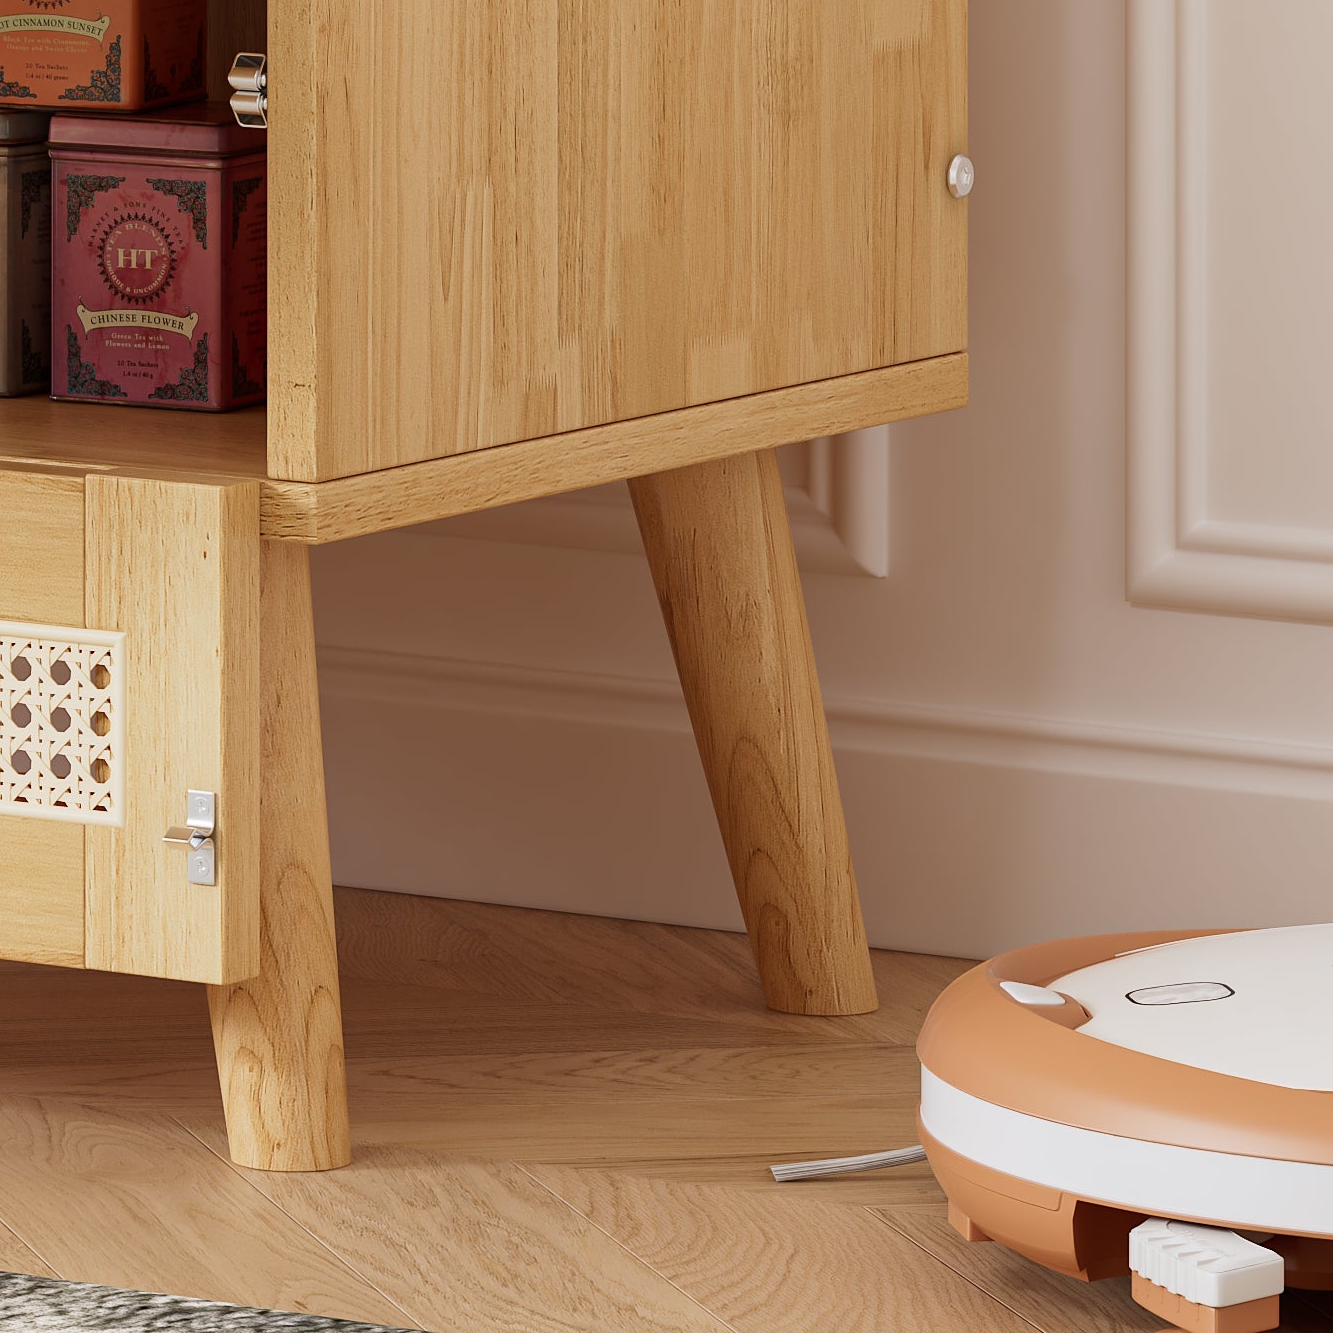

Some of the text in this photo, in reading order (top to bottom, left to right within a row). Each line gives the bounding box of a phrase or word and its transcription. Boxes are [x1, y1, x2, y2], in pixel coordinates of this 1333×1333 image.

[13, 18, 65, 28] CINNAMON
[67, 20, 103, 36] SUNSET
[151, 206, 171, 222] FINE
[106, 222, 167, 255] TEA BLENDS
[116, 248, 159, 270] HT
[106, 260, 125, 288] UNIQUE
[133, 263, 167, 294] UNCOMMON
[90, 313, 184, 331] CHINESE FLOWER
[105, 340, 170, 350] Flowers and Lemon
[111, 332, 164, 342] Green Tea with
